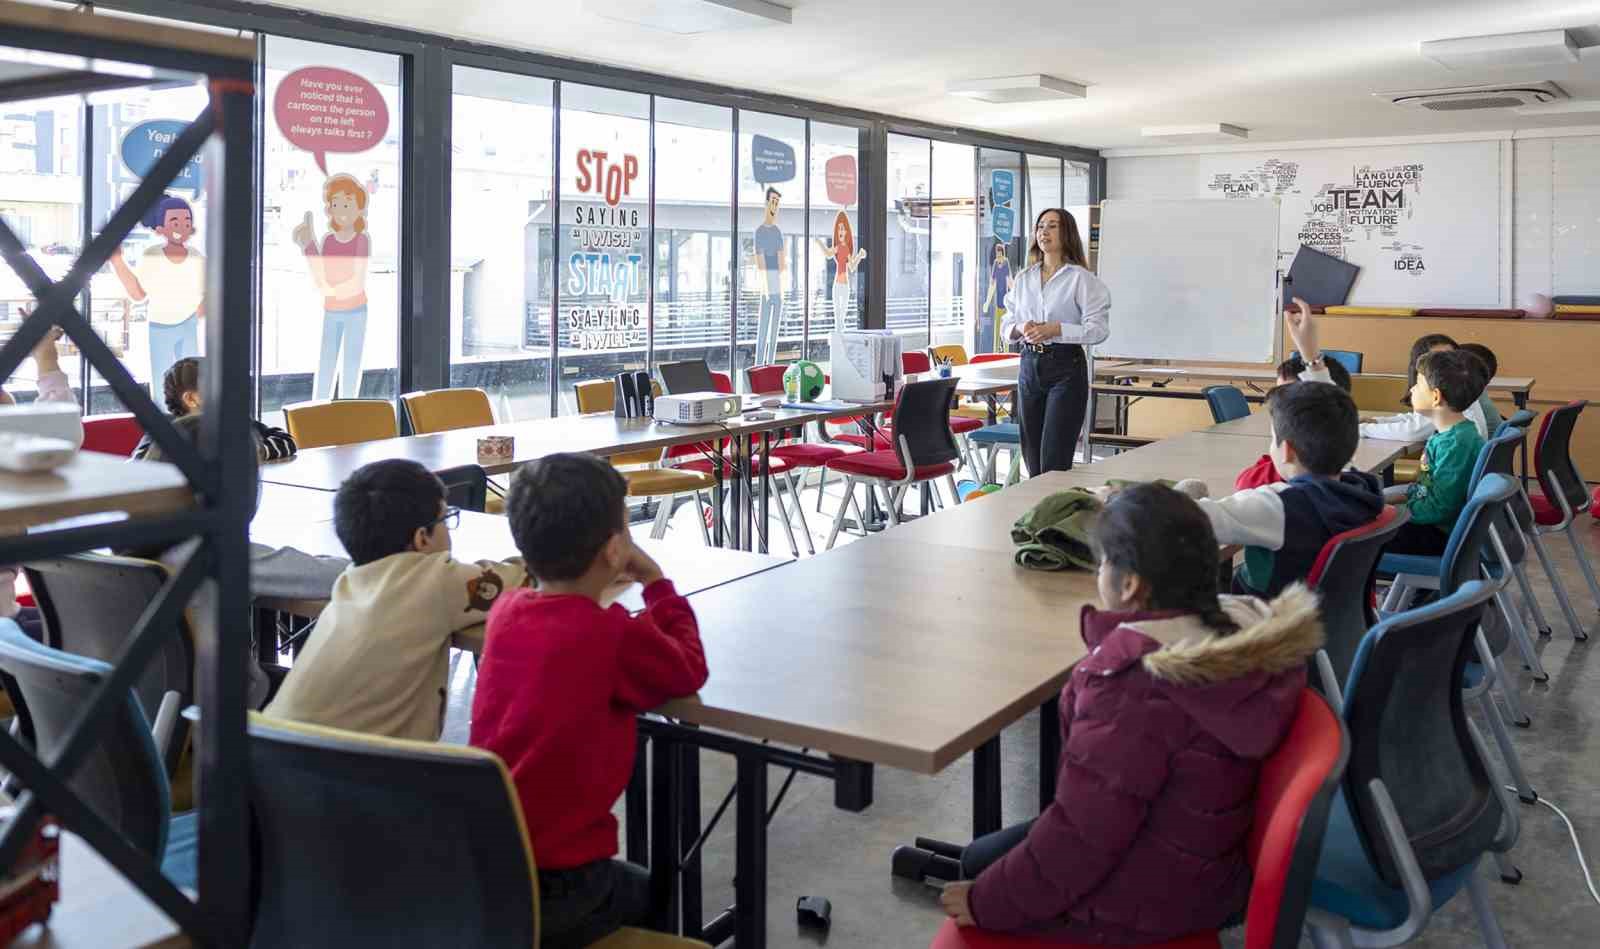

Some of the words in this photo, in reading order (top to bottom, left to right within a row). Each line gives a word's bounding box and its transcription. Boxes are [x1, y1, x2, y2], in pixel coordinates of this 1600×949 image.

[301, 79, 323, 89] Have
[326, 82, 342, 92] you
[344, 85, 363, 93] ever
[301, 91, 335, 102] noticed
[336, 94, 353, 103] that
[355, 95, 364, 104] in
[287, 102, 327, 112] cartoons
[329, 104, 344, 114] the
[345, 108, 375, 119] person
[310, 116, 322, 124] on
[324, 116, 338, 125] the
[340, 117, 354, 126] left
[291, 124, 322, 136] always
[324, 127, 345, 137] talks
[347, 129, 365, 138] first
[576, 148, 639, 206] STOP
[1356, 171, 1418, 180] LANGUAGE
[1223, 183, 1254, 193] PLAN
[1356, 180, 1405, 188] FLUENCY
[1328, 189, 1404, 209] TEAM
[1313, 203, 1334, 213] JOB
[576, 206, 638, 226] SAYING
[1350, 215, 1398, 225] FUTURE
[1297, 232, 1342, 240] PROCESS
[1394, 260, 1425, 270] IDEA
[568, 253, 641, 303] START
[571, 308, 639, 328] SAYING
